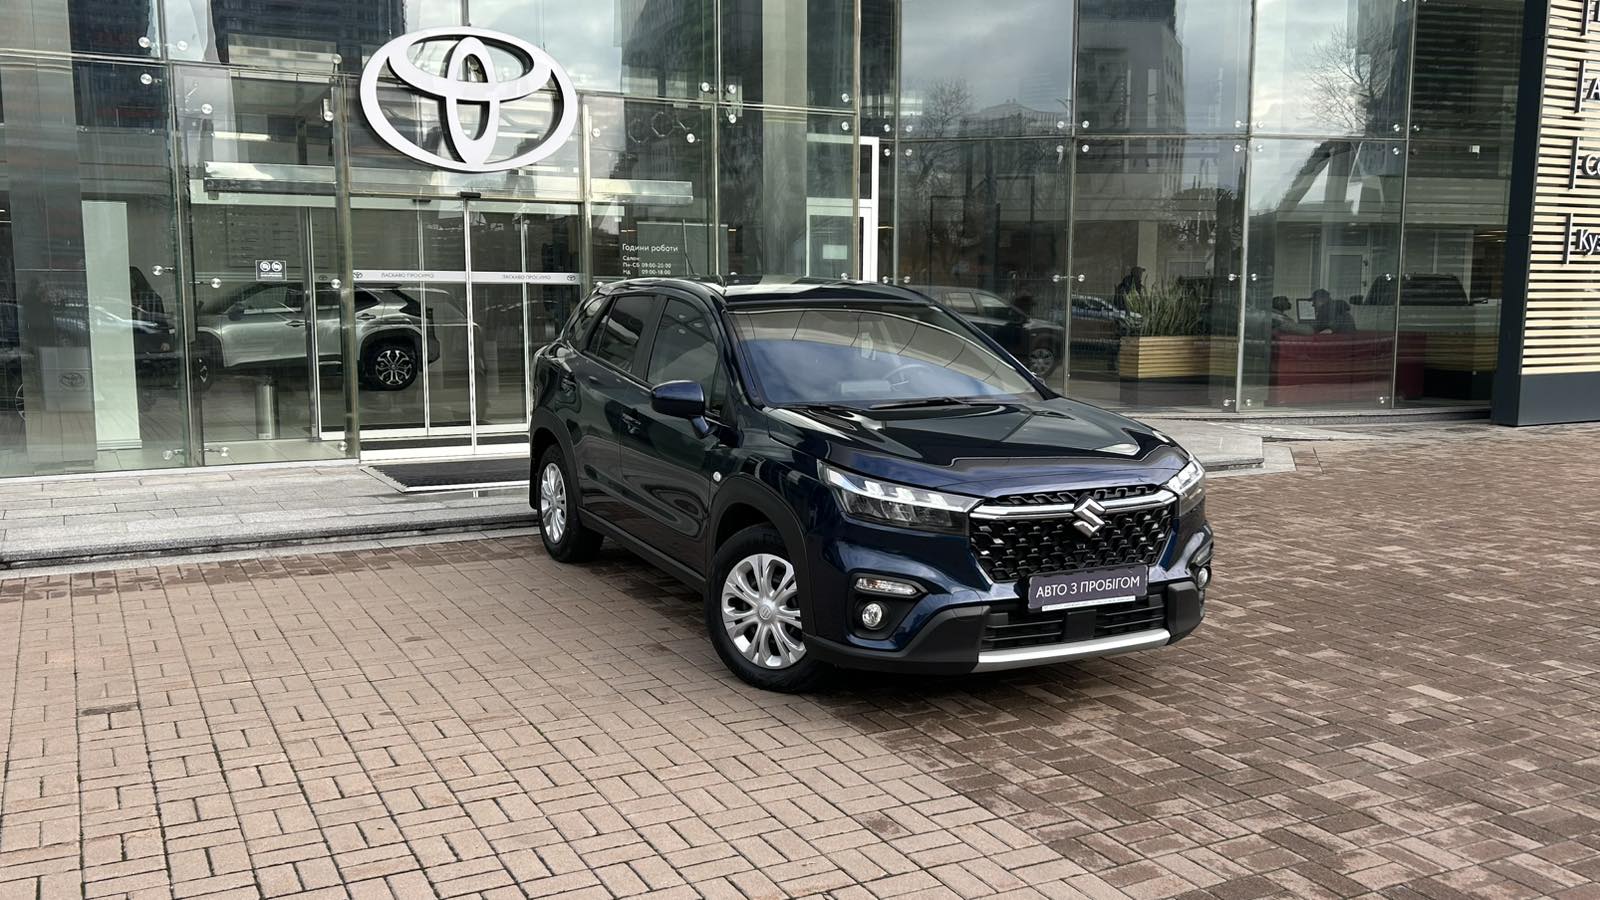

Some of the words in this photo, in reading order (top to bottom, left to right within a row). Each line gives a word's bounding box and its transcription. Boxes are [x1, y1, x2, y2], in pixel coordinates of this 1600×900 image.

[622, 243, 650, 252] Години
[651, 244, 679, 254] роботи
[1035, 584, 1068, 599] АВТО
[1079, 575, 1140, 593] ПРОБІГОМ
